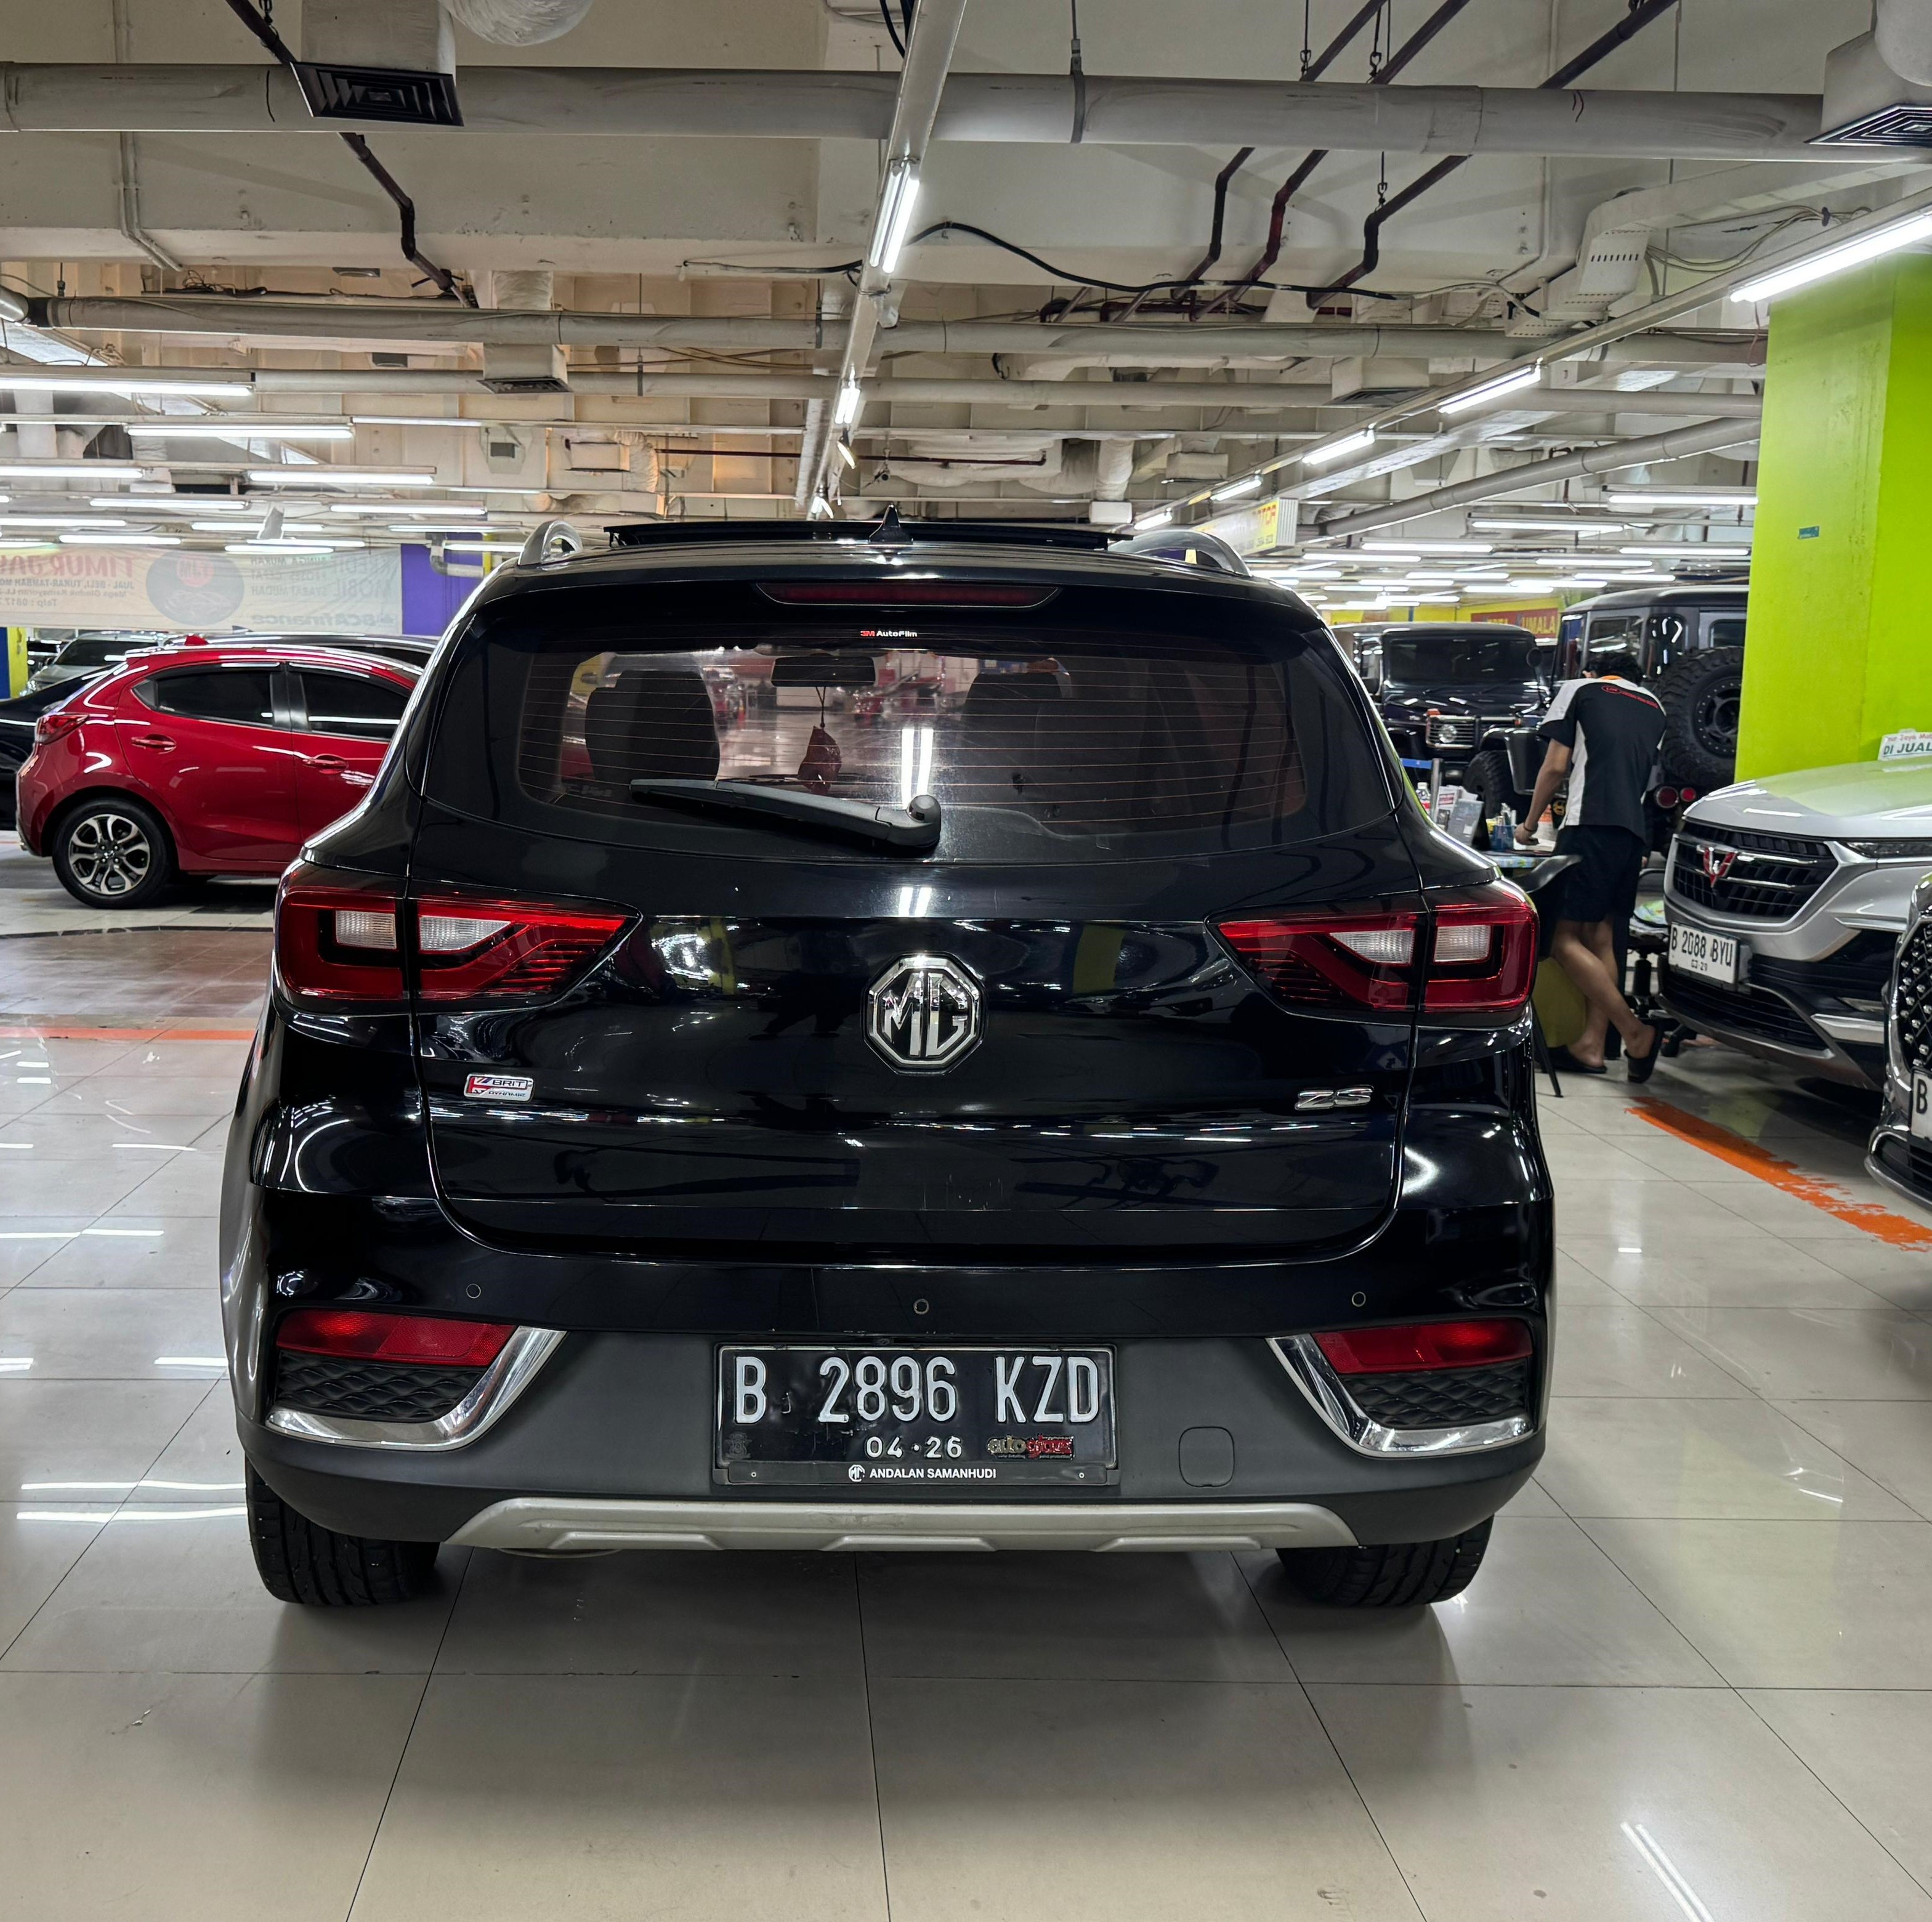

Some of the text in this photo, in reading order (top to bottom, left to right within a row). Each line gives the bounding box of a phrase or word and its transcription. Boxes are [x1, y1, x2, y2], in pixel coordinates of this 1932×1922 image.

[1883, 742, 1932, 755] DI JUAL
[1671, 927, 1733, 968] B 2088 BYU
[880, 969, 970, 1059] MG
[492, 1079, 525, 1087] BRIT
[1295, 1085, 1373, 1110] ZS
[1915, 1079, 1928, 1114] B
[735, 1356, 767, 1424] B
[818, 1356, 956, 1422] 2896
[995, 1355, 1099, 1423] KZD
[869, 1468, 924, 1478] ANDALAN
[927, 1468, 996, 1478] SAMANHUDI
